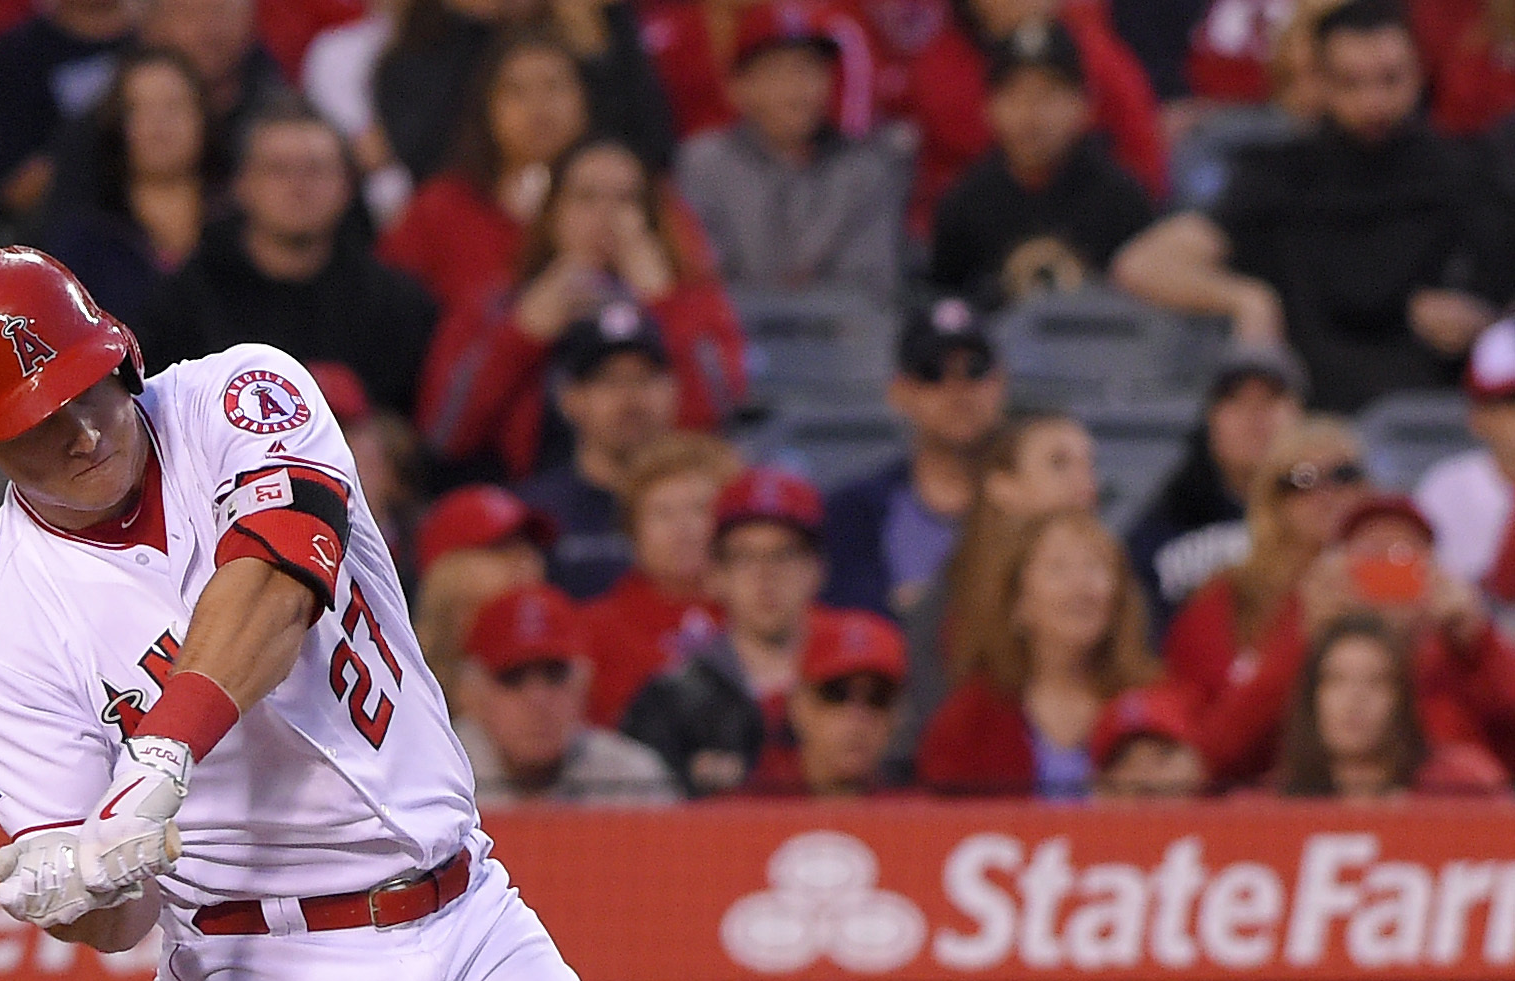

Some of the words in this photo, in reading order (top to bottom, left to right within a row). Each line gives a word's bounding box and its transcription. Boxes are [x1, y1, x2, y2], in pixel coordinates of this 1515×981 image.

[227, 370, 285, 396] ANGELS
[255, 482, 283, 503] 27
[329, 576, 404, 751] 27
[931, 832, 1515, 970] StateFar
